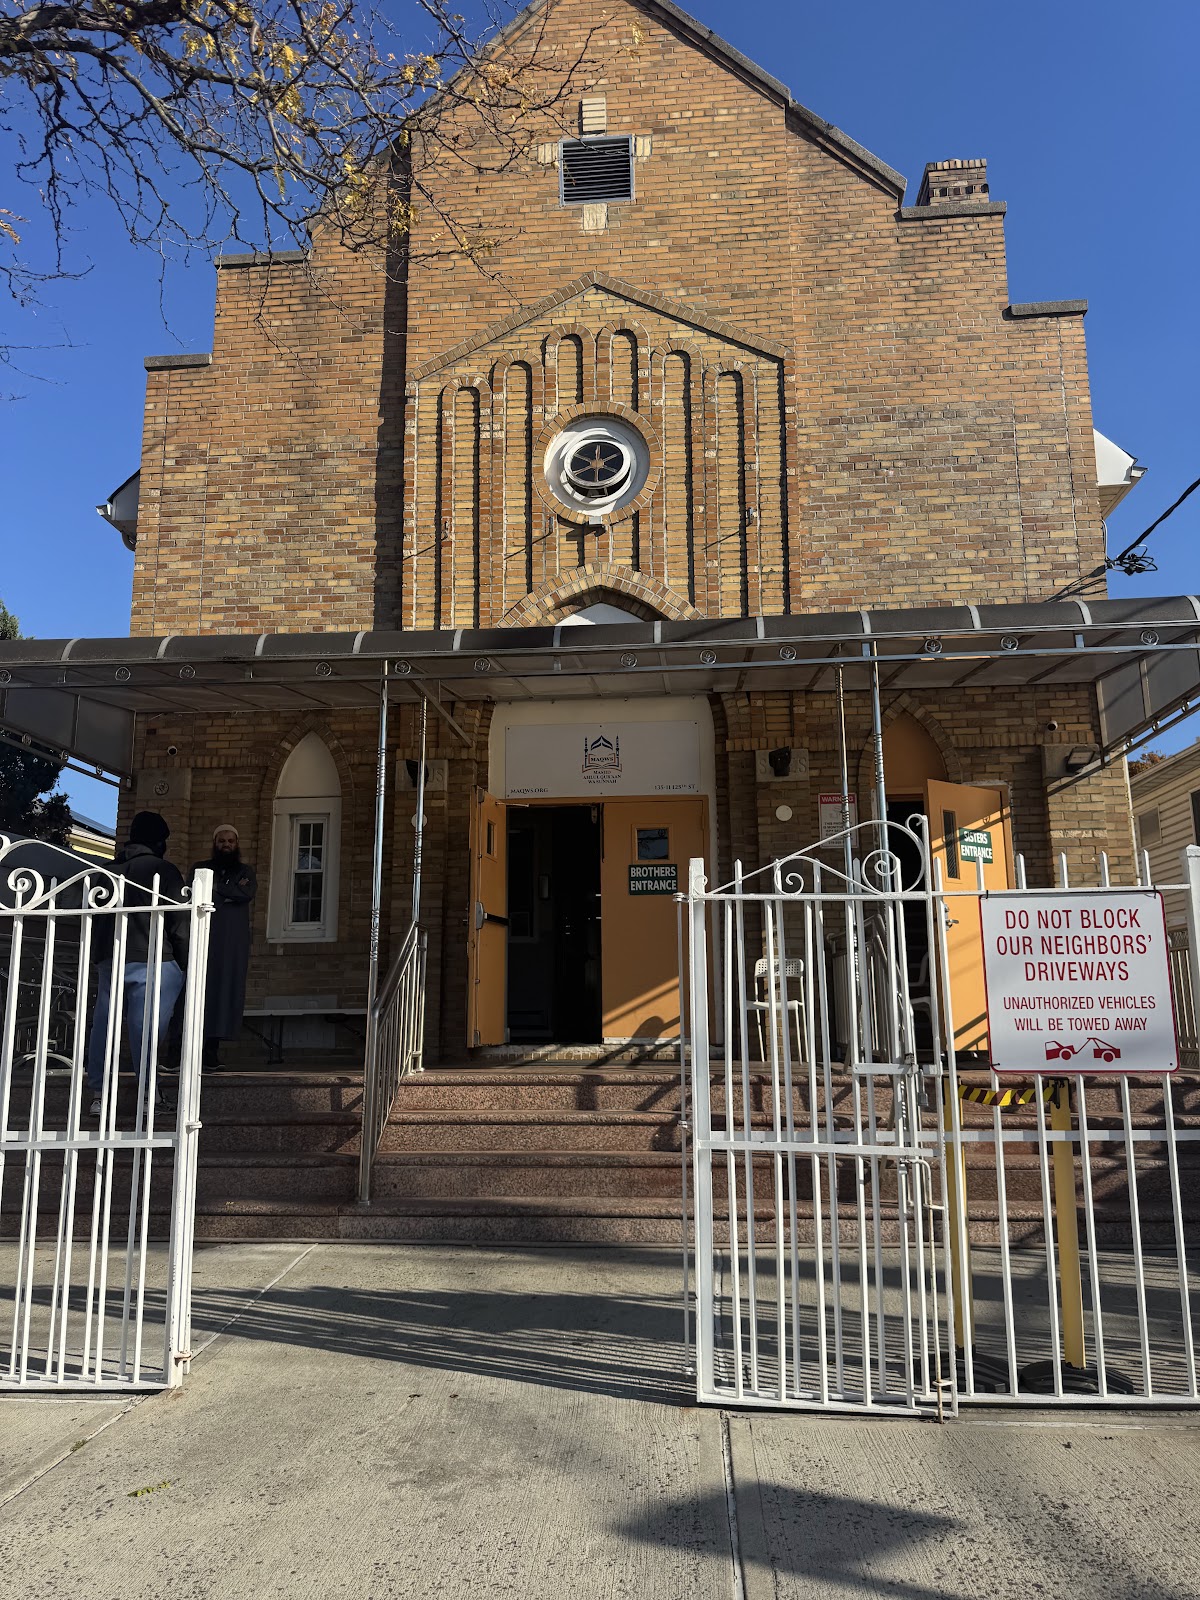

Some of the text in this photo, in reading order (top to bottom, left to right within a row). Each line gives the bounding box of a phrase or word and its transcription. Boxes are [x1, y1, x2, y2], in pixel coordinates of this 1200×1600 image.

[964, 831, 988, 844] SISTERS
[961, 845, 993, 859] ENTRANCE
[631, 867, 676, 877] BROTHERS
[631, 880, 677, 890] ENTRANCE
[1005, 908, 1141, 929] DO NOT BLOCK
[996, 934, 1152, 956] OUR NEIGHBORS'
[1024, 960, 1129, 981] DRIVEWAYS
[1003, 995, 1156, 1010] UNAUTHORIZED VEHICLES
[1014, 1017, 1148, 1031] WILL BE TOWED AWAY
